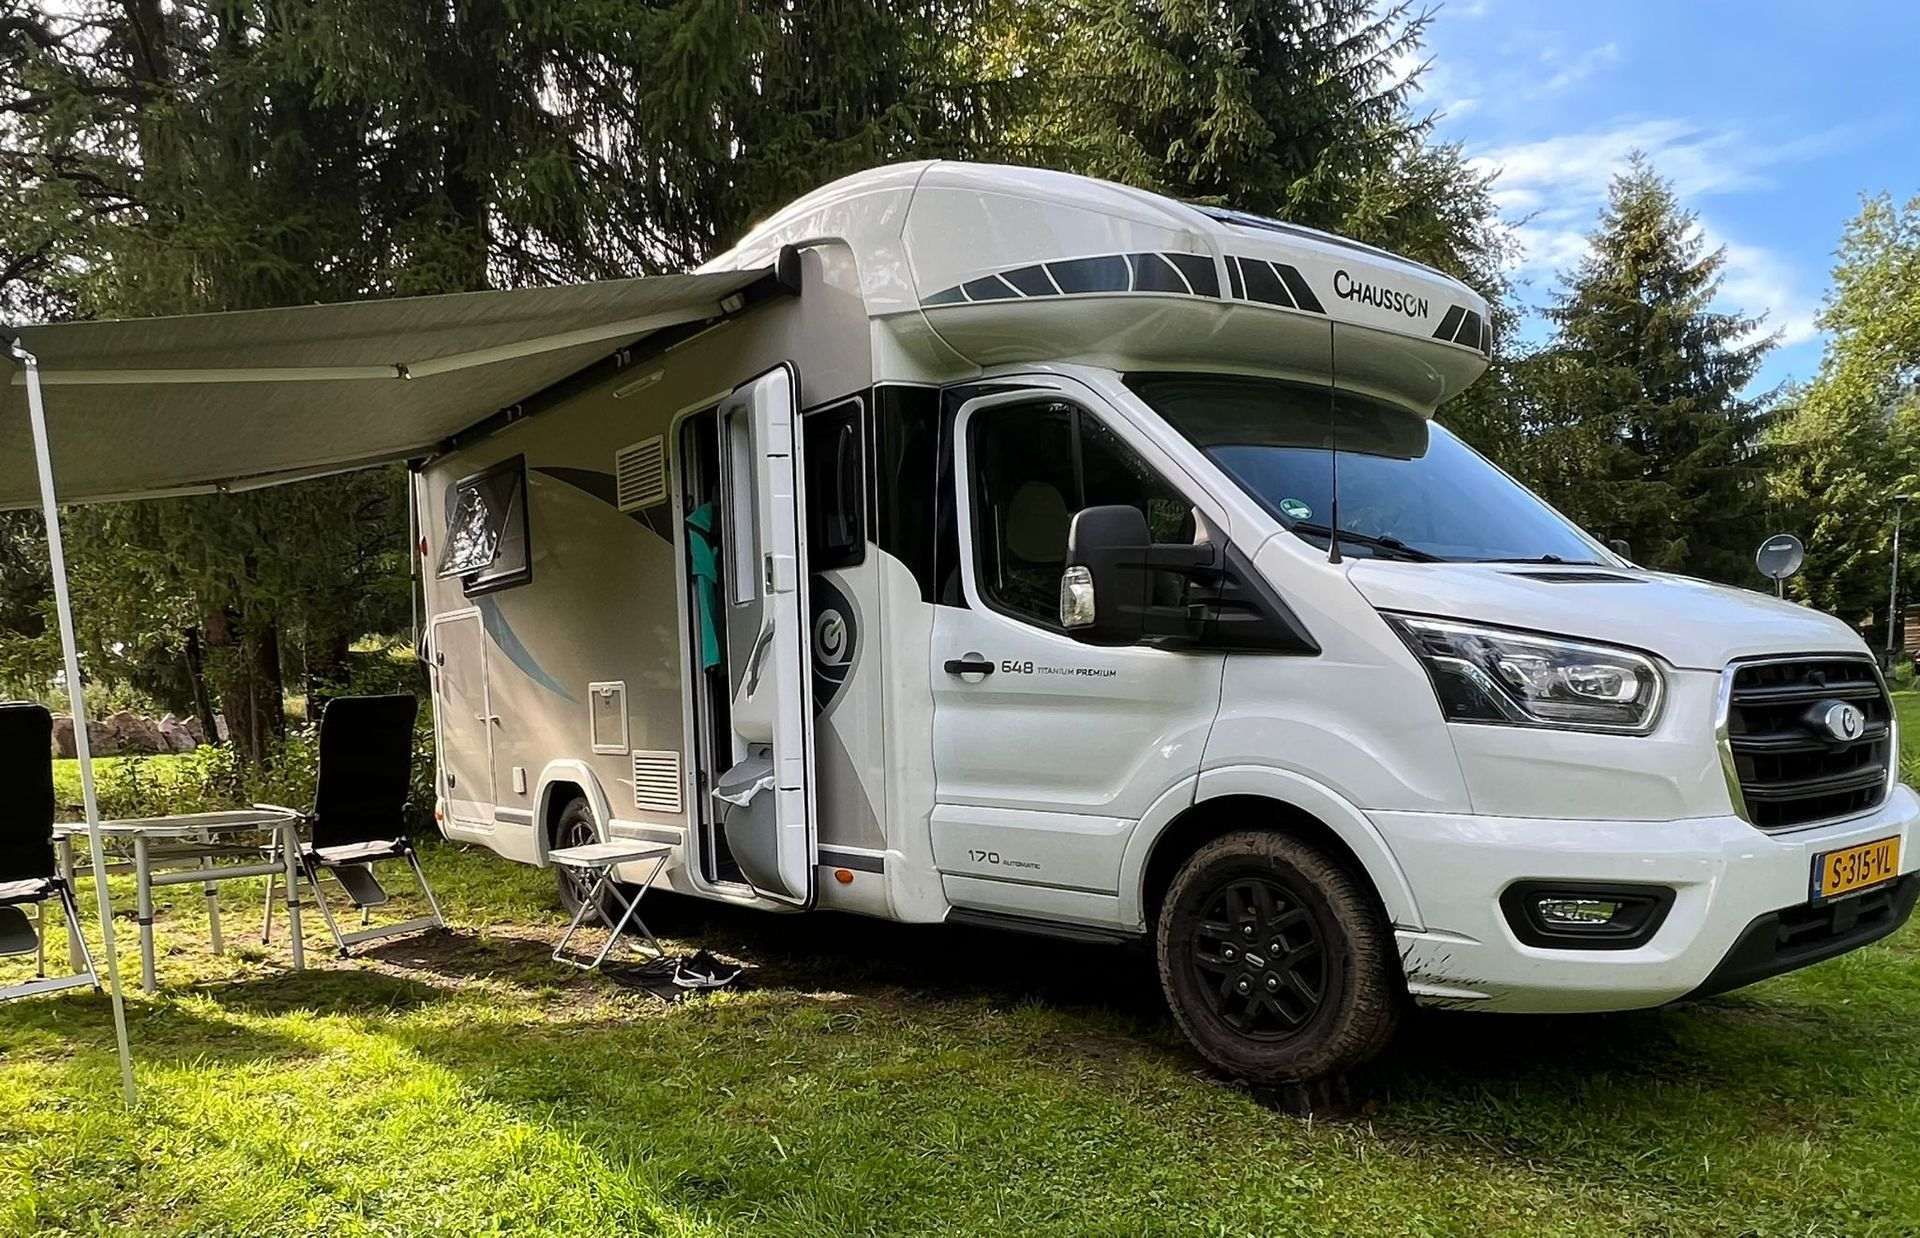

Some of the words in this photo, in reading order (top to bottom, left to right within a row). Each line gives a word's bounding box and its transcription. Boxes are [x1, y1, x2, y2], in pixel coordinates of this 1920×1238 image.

[1333, 269, 1429, 319] CHAUSSON
[1001, 660, 1034, 674] 648
[1037, 666, 1075, 676] TITANIUM
[1075, 668, 1117, 677] PREMIUM
[968, 849, 1000, 864] 170
[1831, 844, 1892, 888] S-315-VL
